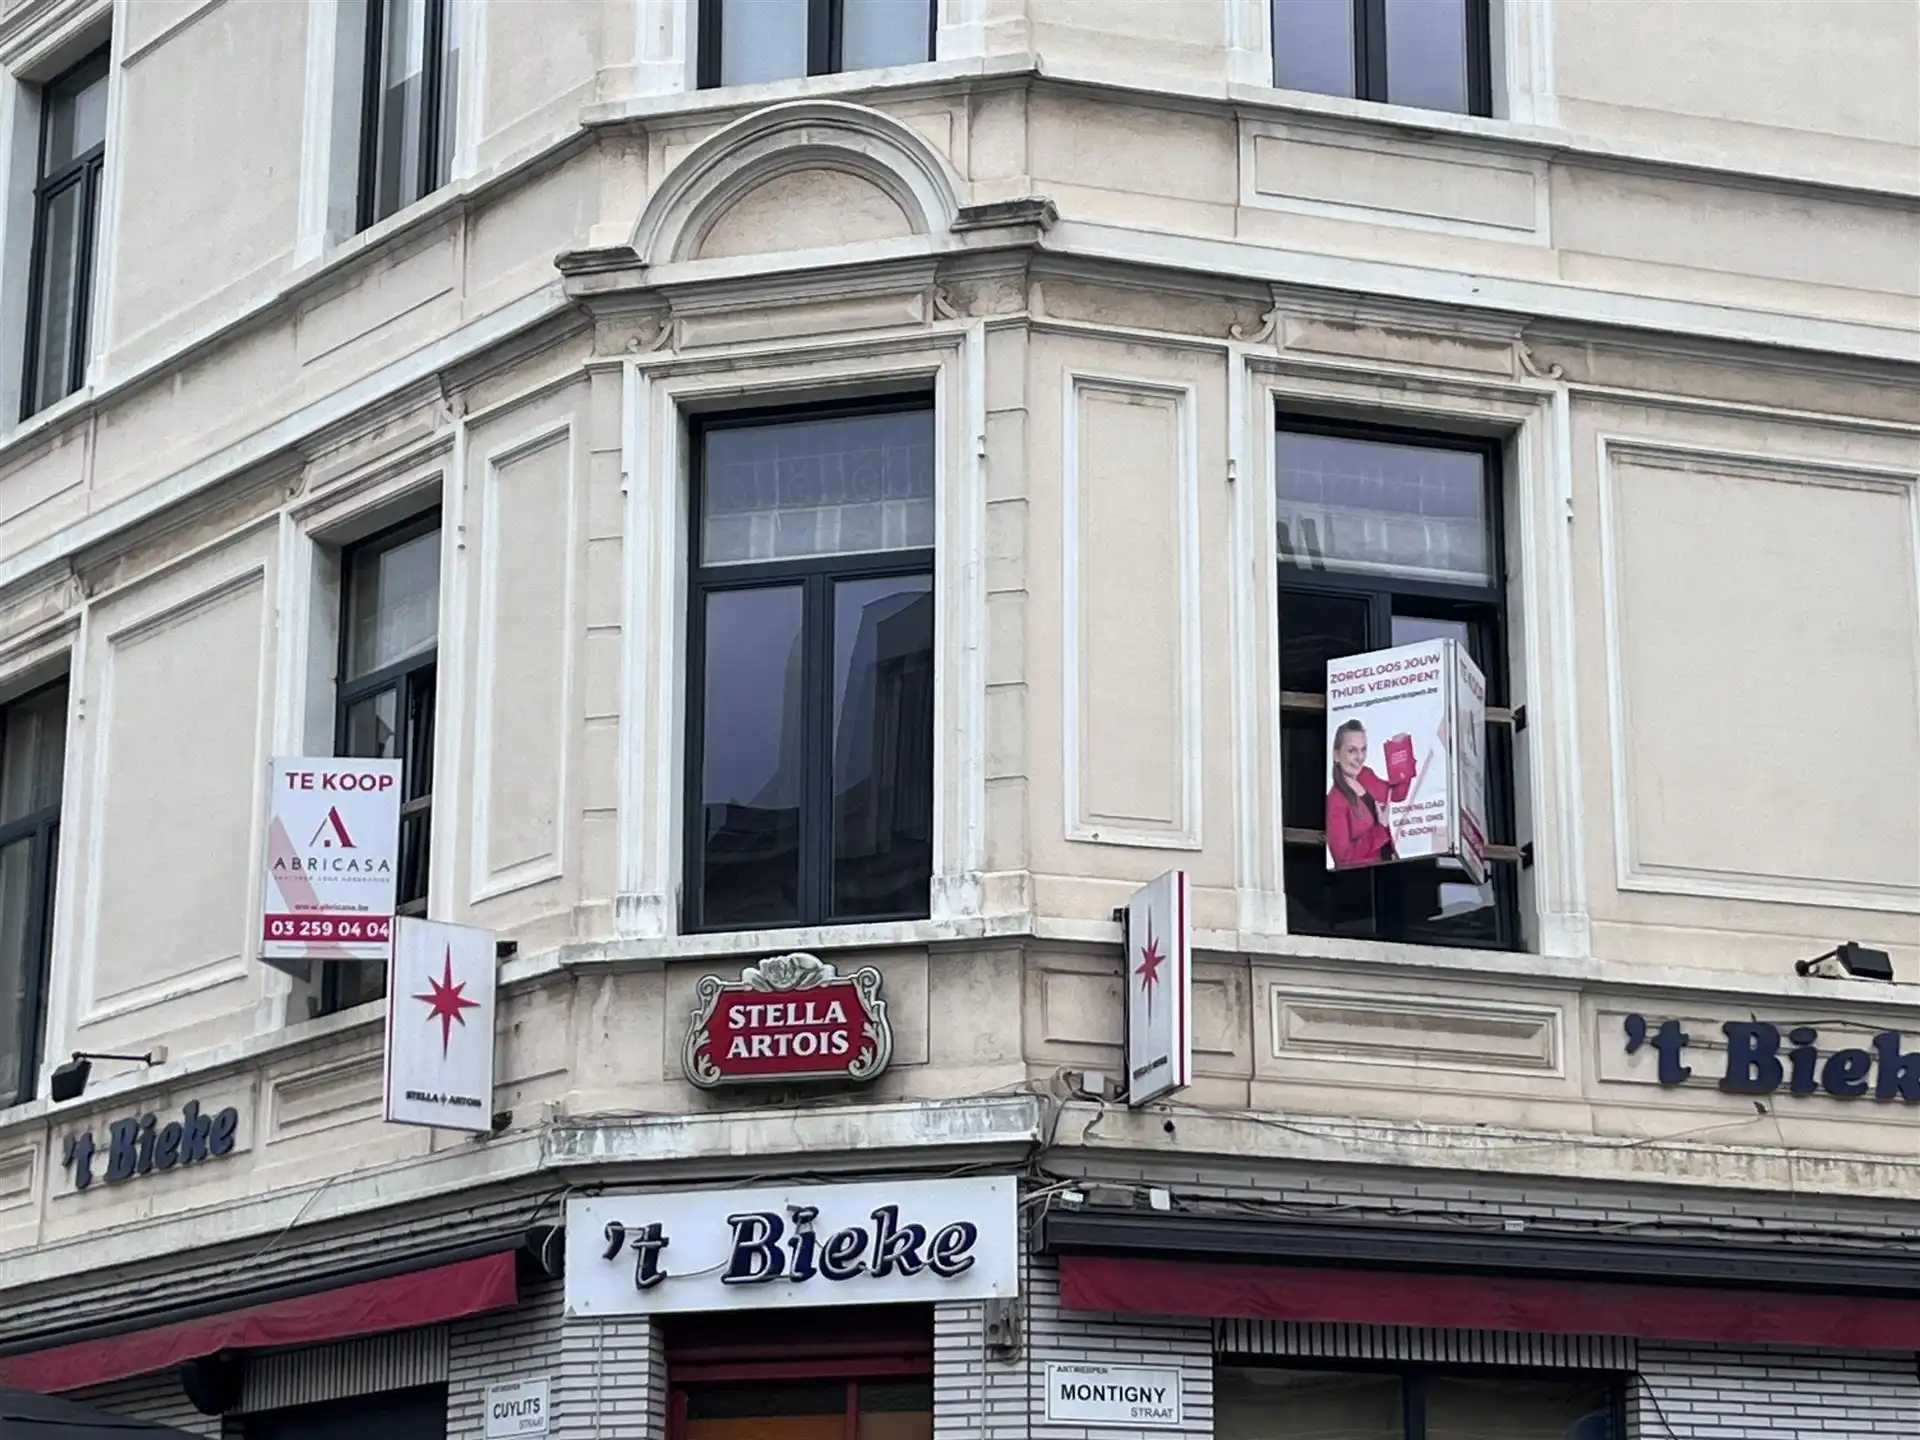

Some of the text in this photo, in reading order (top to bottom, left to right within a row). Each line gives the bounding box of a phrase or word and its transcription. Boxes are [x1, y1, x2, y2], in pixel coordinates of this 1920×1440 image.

[1330, 652, 1441, 684] ZORGELOOS JOUW
[1331, 669, 1440, 699] THUIS VERKOPEN?
[285, 772, 393, 792] TE KOOP
[274, 857, 390, 872] ABRICASA
[271, 921, 389, 938] 03 259 04 04
[727, 1000, 847, 1030] STELLA
[726, 1030, 849, 1060] ARTOIS
[1624, 1013, 1691, 1085] 't
[62, 1099, 239, 1190] 't Bieke
[602, 1204, 978, 1291] 't Bieke
[493, 1397, 541, 1419] CUYLITS
[1060, 1383, 1166, 1404] MONTIGNY
[1130, 1406, 1174, 1419] STRAAT
